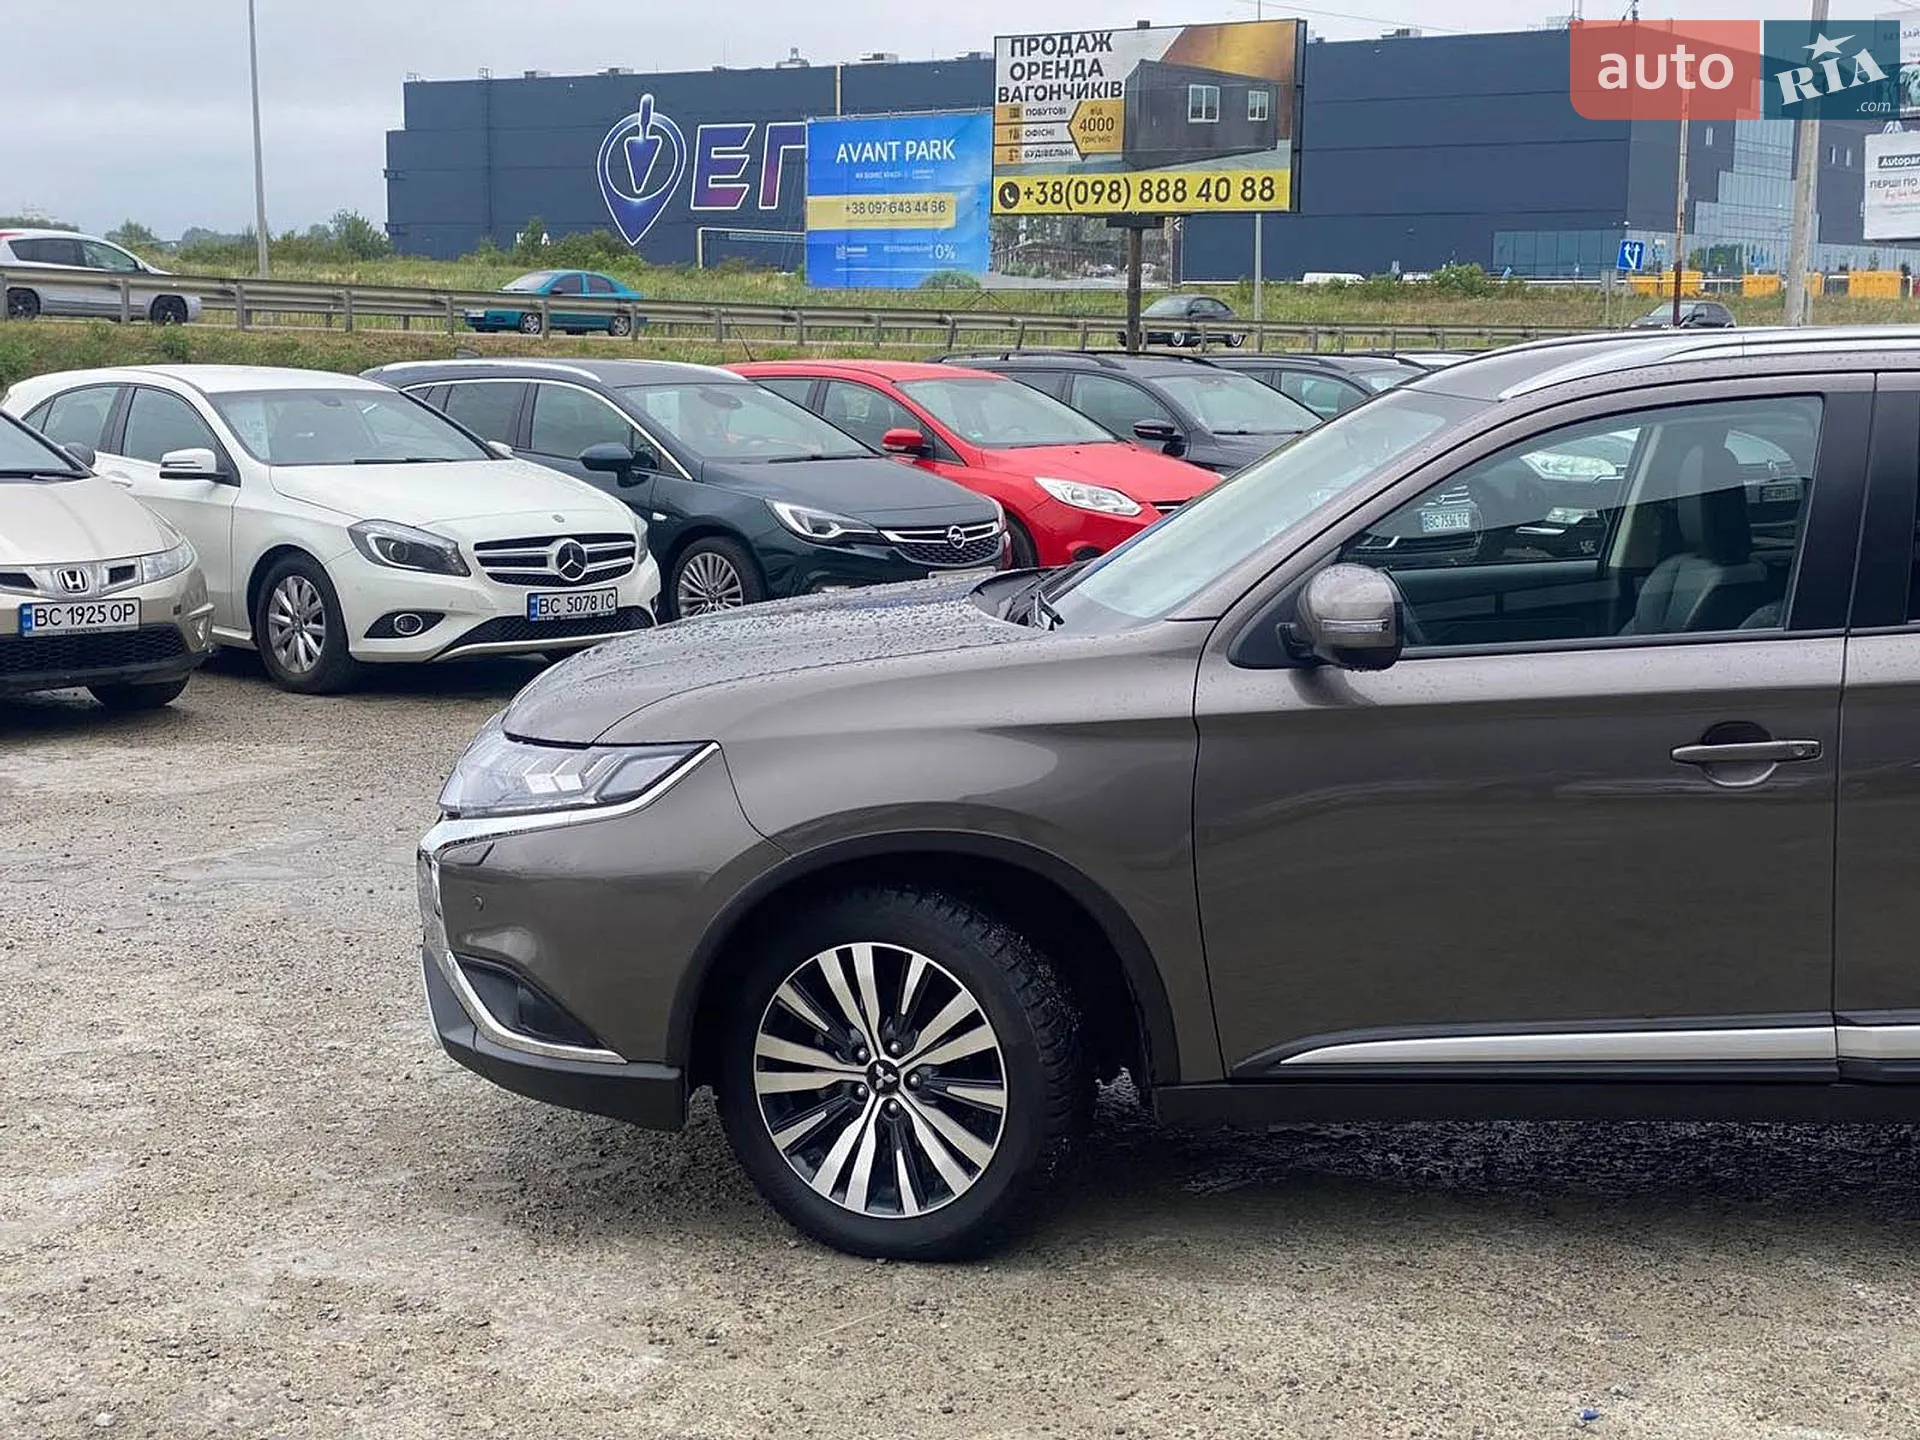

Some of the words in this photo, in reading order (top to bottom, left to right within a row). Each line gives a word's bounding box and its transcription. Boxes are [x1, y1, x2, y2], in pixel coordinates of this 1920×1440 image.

[1010, 33, 1112, 58] ПРОДАЖ
[1009, 58, 1103, 81] ОРЕНДА
[998, 81, 1122, 103] ВАГОНЧИКІВ
[1079, 116, 1114, 132] 4000
[835, 141, 901, 163] AVANT
[904, 138, 956, 162] PARK
[1024, 177, 1131, 211] +38(098)
[1139, 177, 1188, 204] 888
[1195, 176, 1231, 203] 40
[1240, 176, 1275, 202] 88
[34, 607, 62, 627] BC
[66, 605, 107, 626] 1925
[110, 603, 136, 623] OP
[539, 597, 560, 614] BC
[566, 594, 598, 613] 5078
